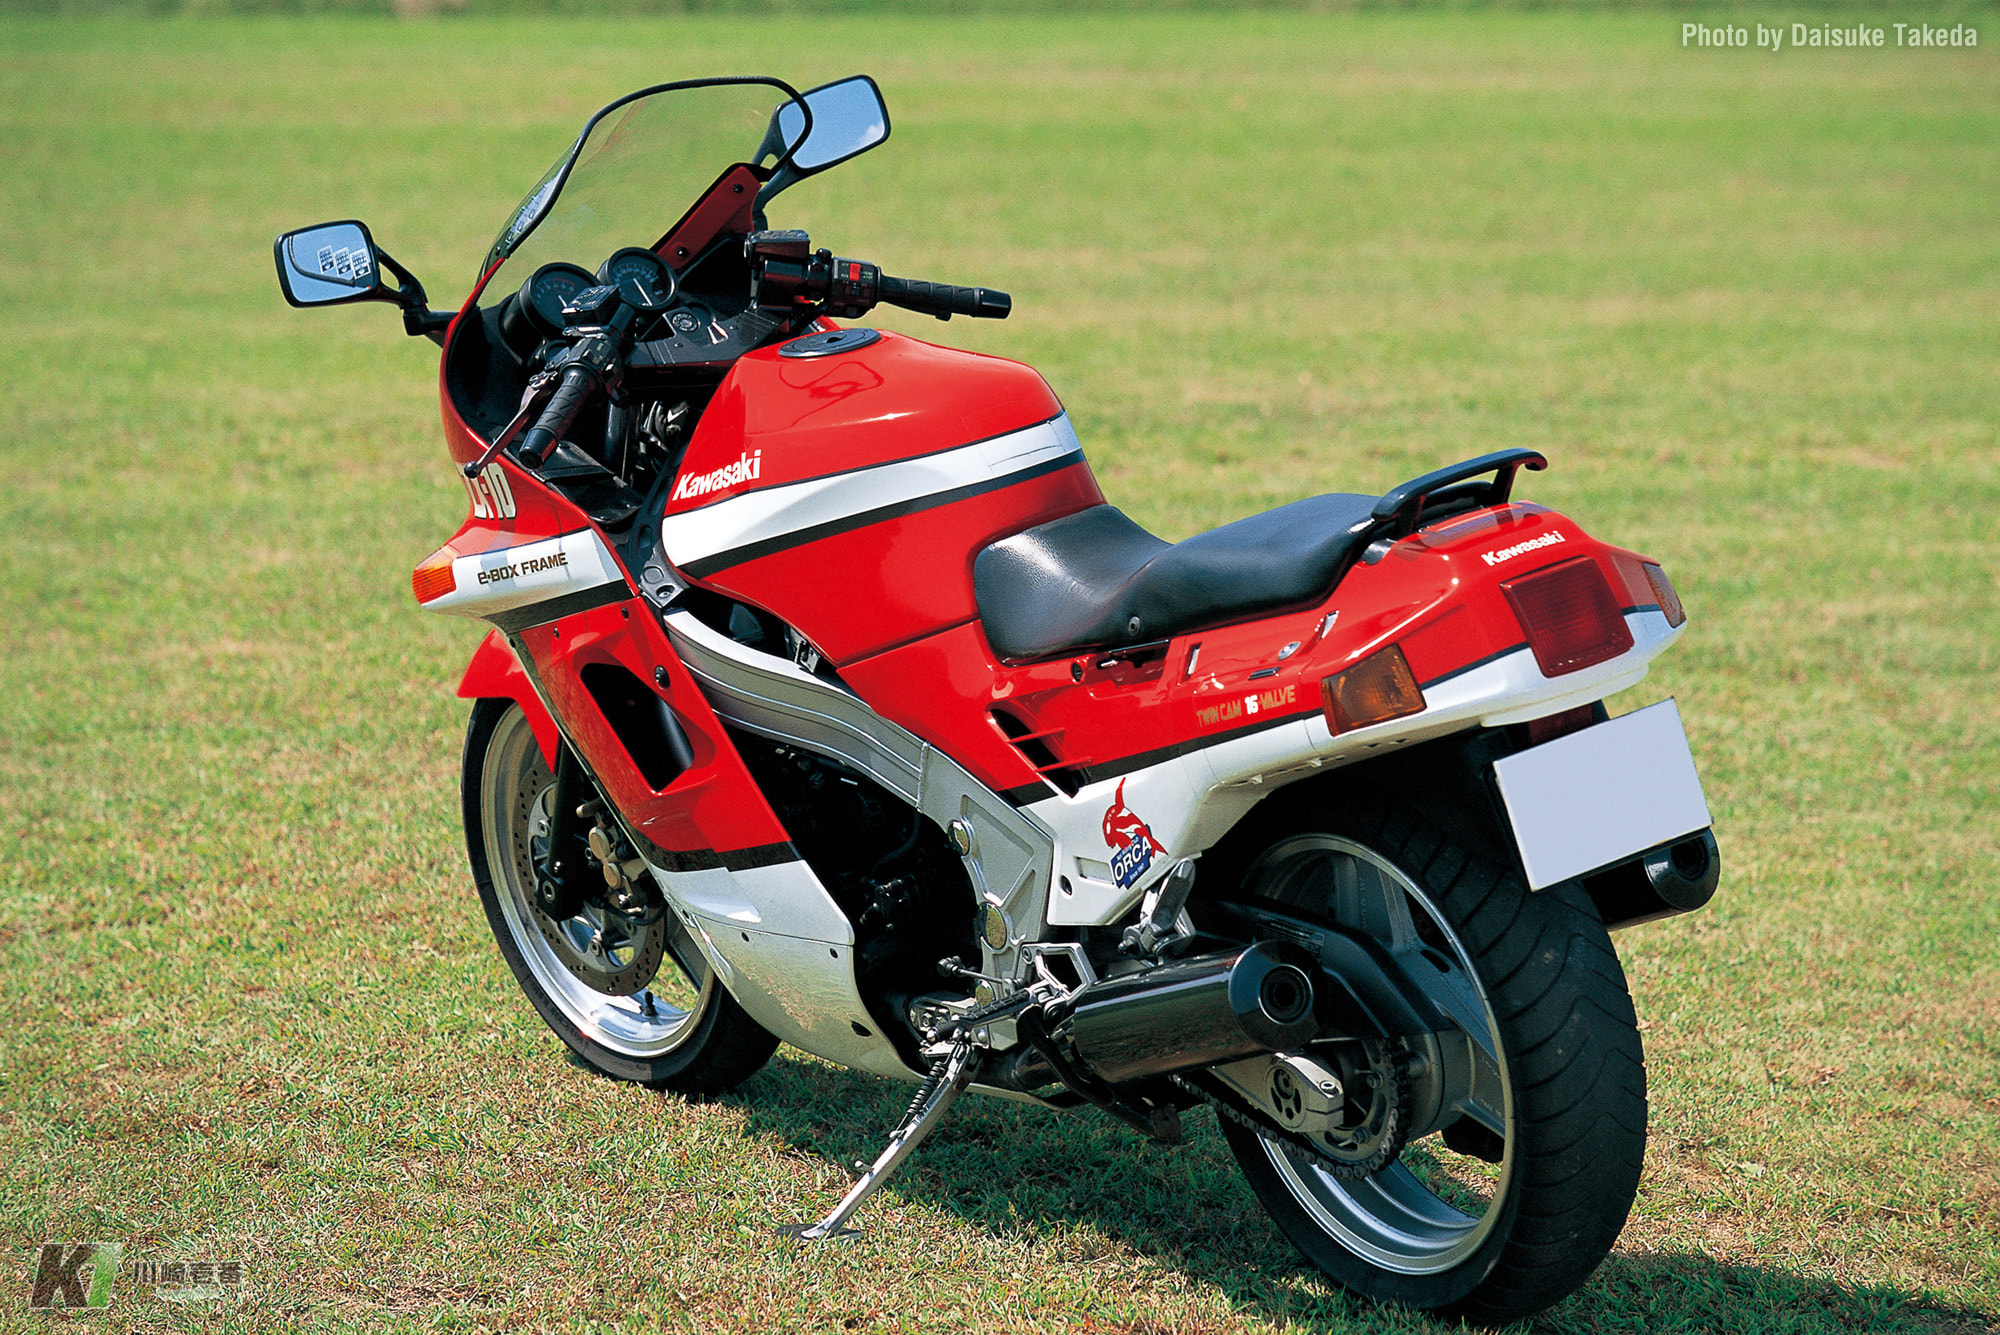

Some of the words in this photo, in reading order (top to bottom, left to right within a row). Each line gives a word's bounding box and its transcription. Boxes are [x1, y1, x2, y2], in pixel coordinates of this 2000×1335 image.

[672, 449, 762, 501] Kawasaki
[521, 552, 569, 576] FRAME
[1481, 530, 1566, 567] Kawasaki
[1196, 705, 1220, 728] TWIN
[1220, 699, 1242, 721] CAM
[1114, 835, 1153, 881] ORCA
